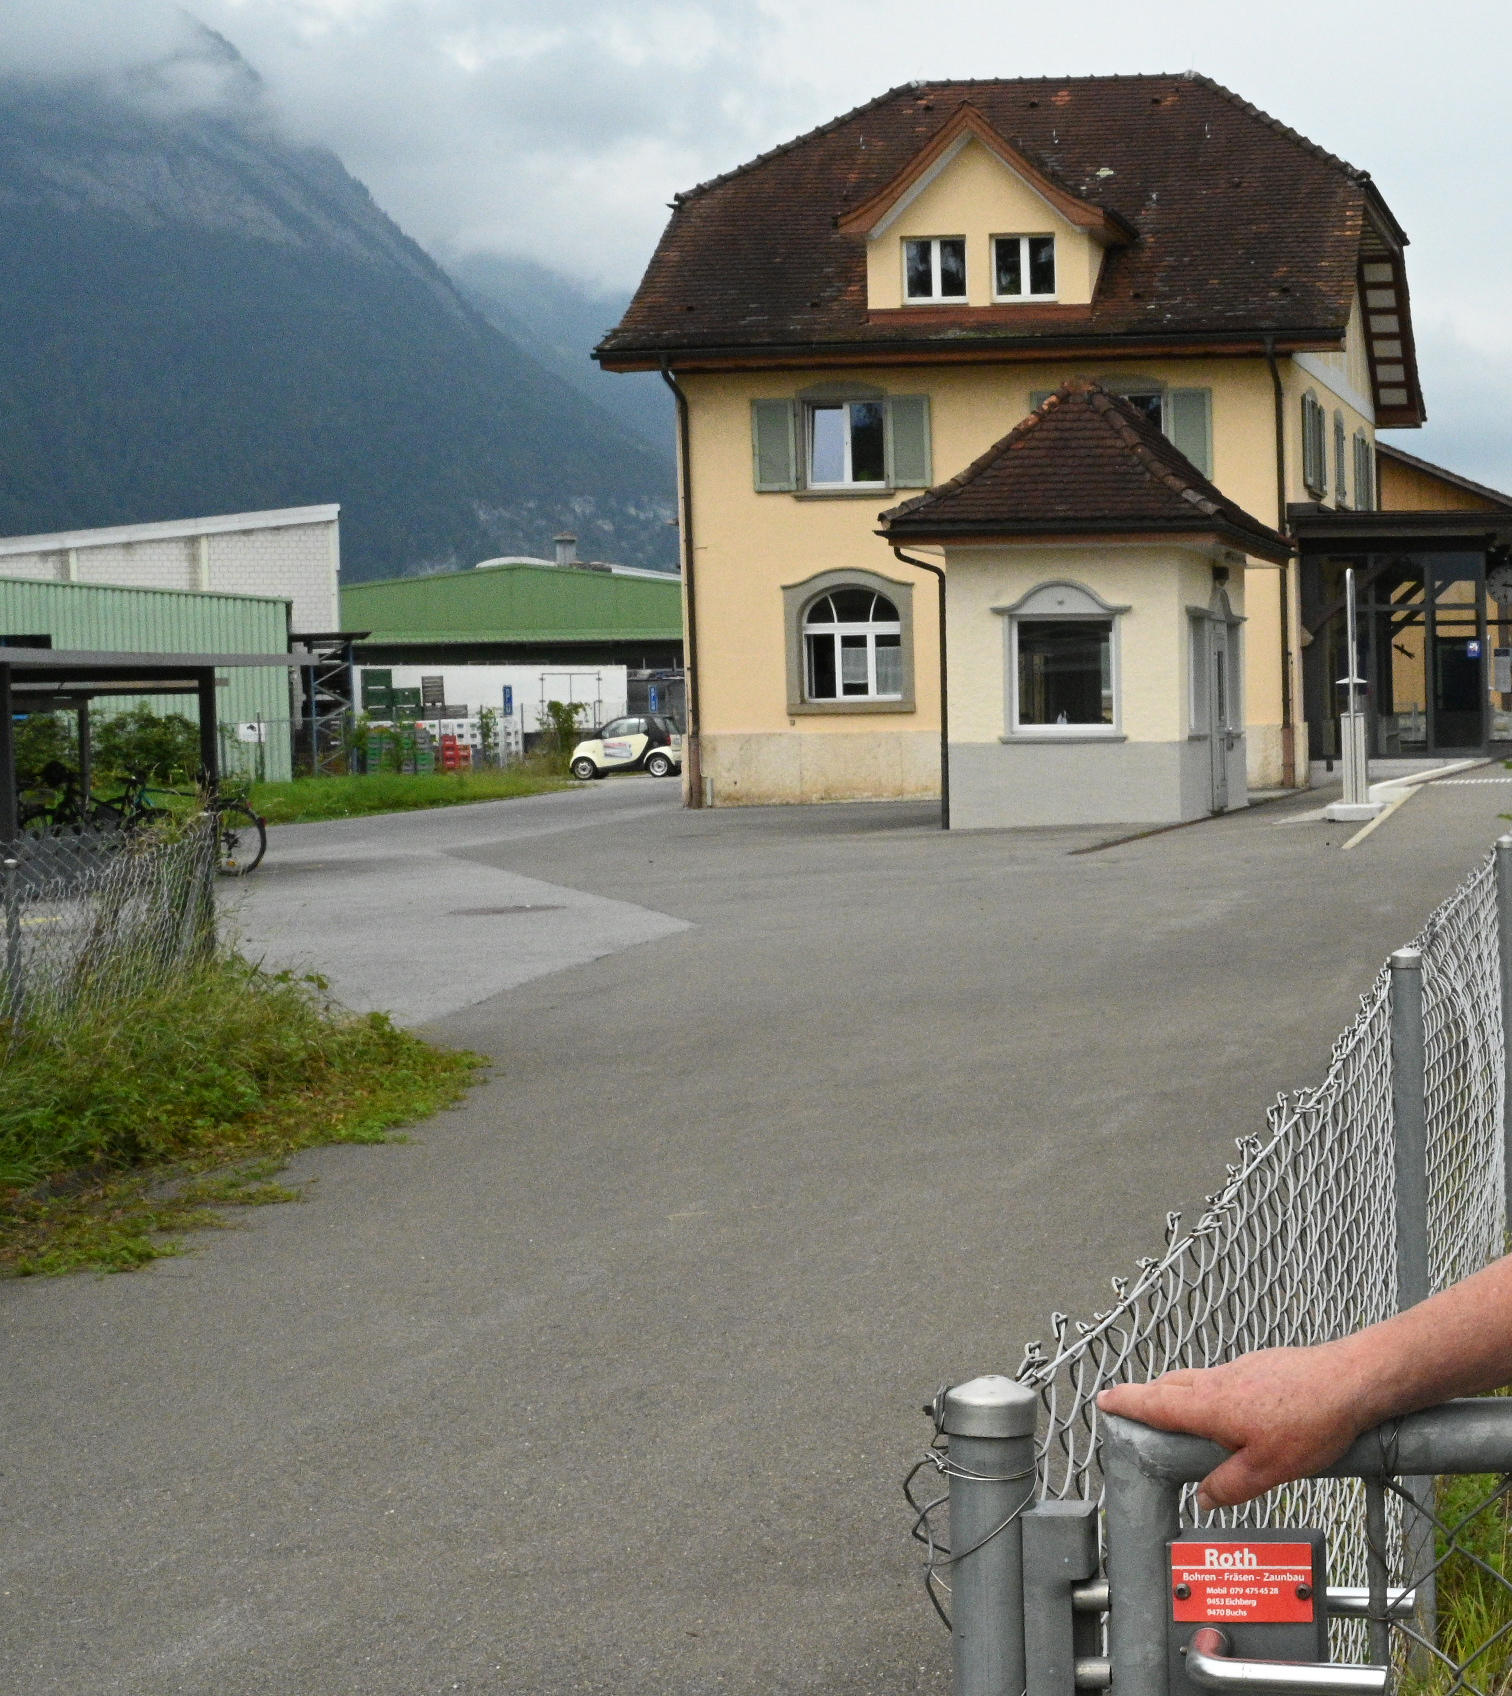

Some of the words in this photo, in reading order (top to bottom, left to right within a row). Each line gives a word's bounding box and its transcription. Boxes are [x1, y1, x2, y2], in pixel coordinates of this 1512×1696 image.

[1205, 1548, 1257, 1567] Roth
[1183, 1572, 1216, 1581] Bohren
[1224, 1572, 1254, 1581] Fräsen
[1263, 1572, 1305, 1581] Zaunbau
[1225, 1598, 1257, 1607] Eichberg
[1225, 1608, 1248, 1616] Buchs
